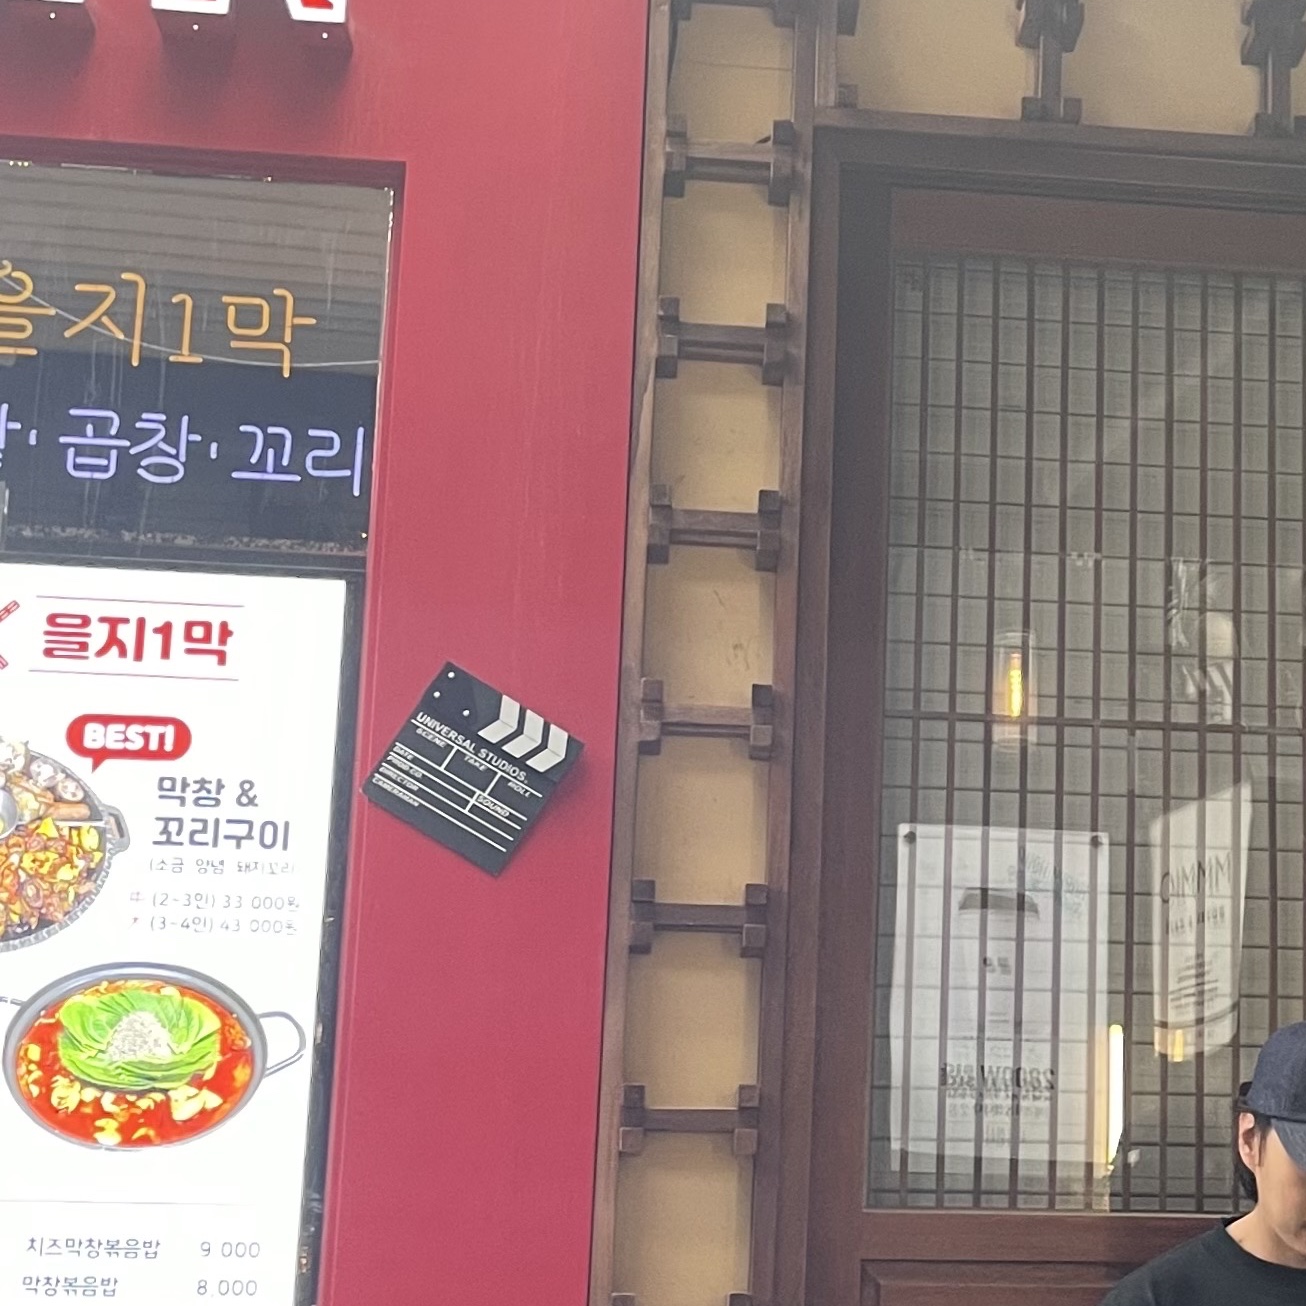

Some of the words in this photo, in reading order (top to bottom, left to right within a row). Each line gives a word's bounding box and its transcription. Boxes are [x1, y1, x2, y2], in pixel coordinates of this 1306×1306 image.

[43, 613, 234, 666] 을지1막
[82, 722, 175, 752] BEST!
[415, 728, 447, 748] SCENE
[416, 711, 476, 754] UNIVERSAL
[392, 746, 414, 761] DATE
[464, 756, 488, 772] TAKE
[157, 776, 226, 808] 막창
[235, 779, 259, 808] &
[507, 781, 532, 798] ROLL
[477, 795, 511, 818] SOUND
[152, 816, 290, 851] 꼬리구이
[149, 857, 185, 874] (소금
[195, 858, 225, 875] 양념
[26, 1237, 161, 1259] 치즈막창볶음밥
[200, 1241, 261, 1258] 9000
[22, 1276, 119, 1297] 막창볶음밥
